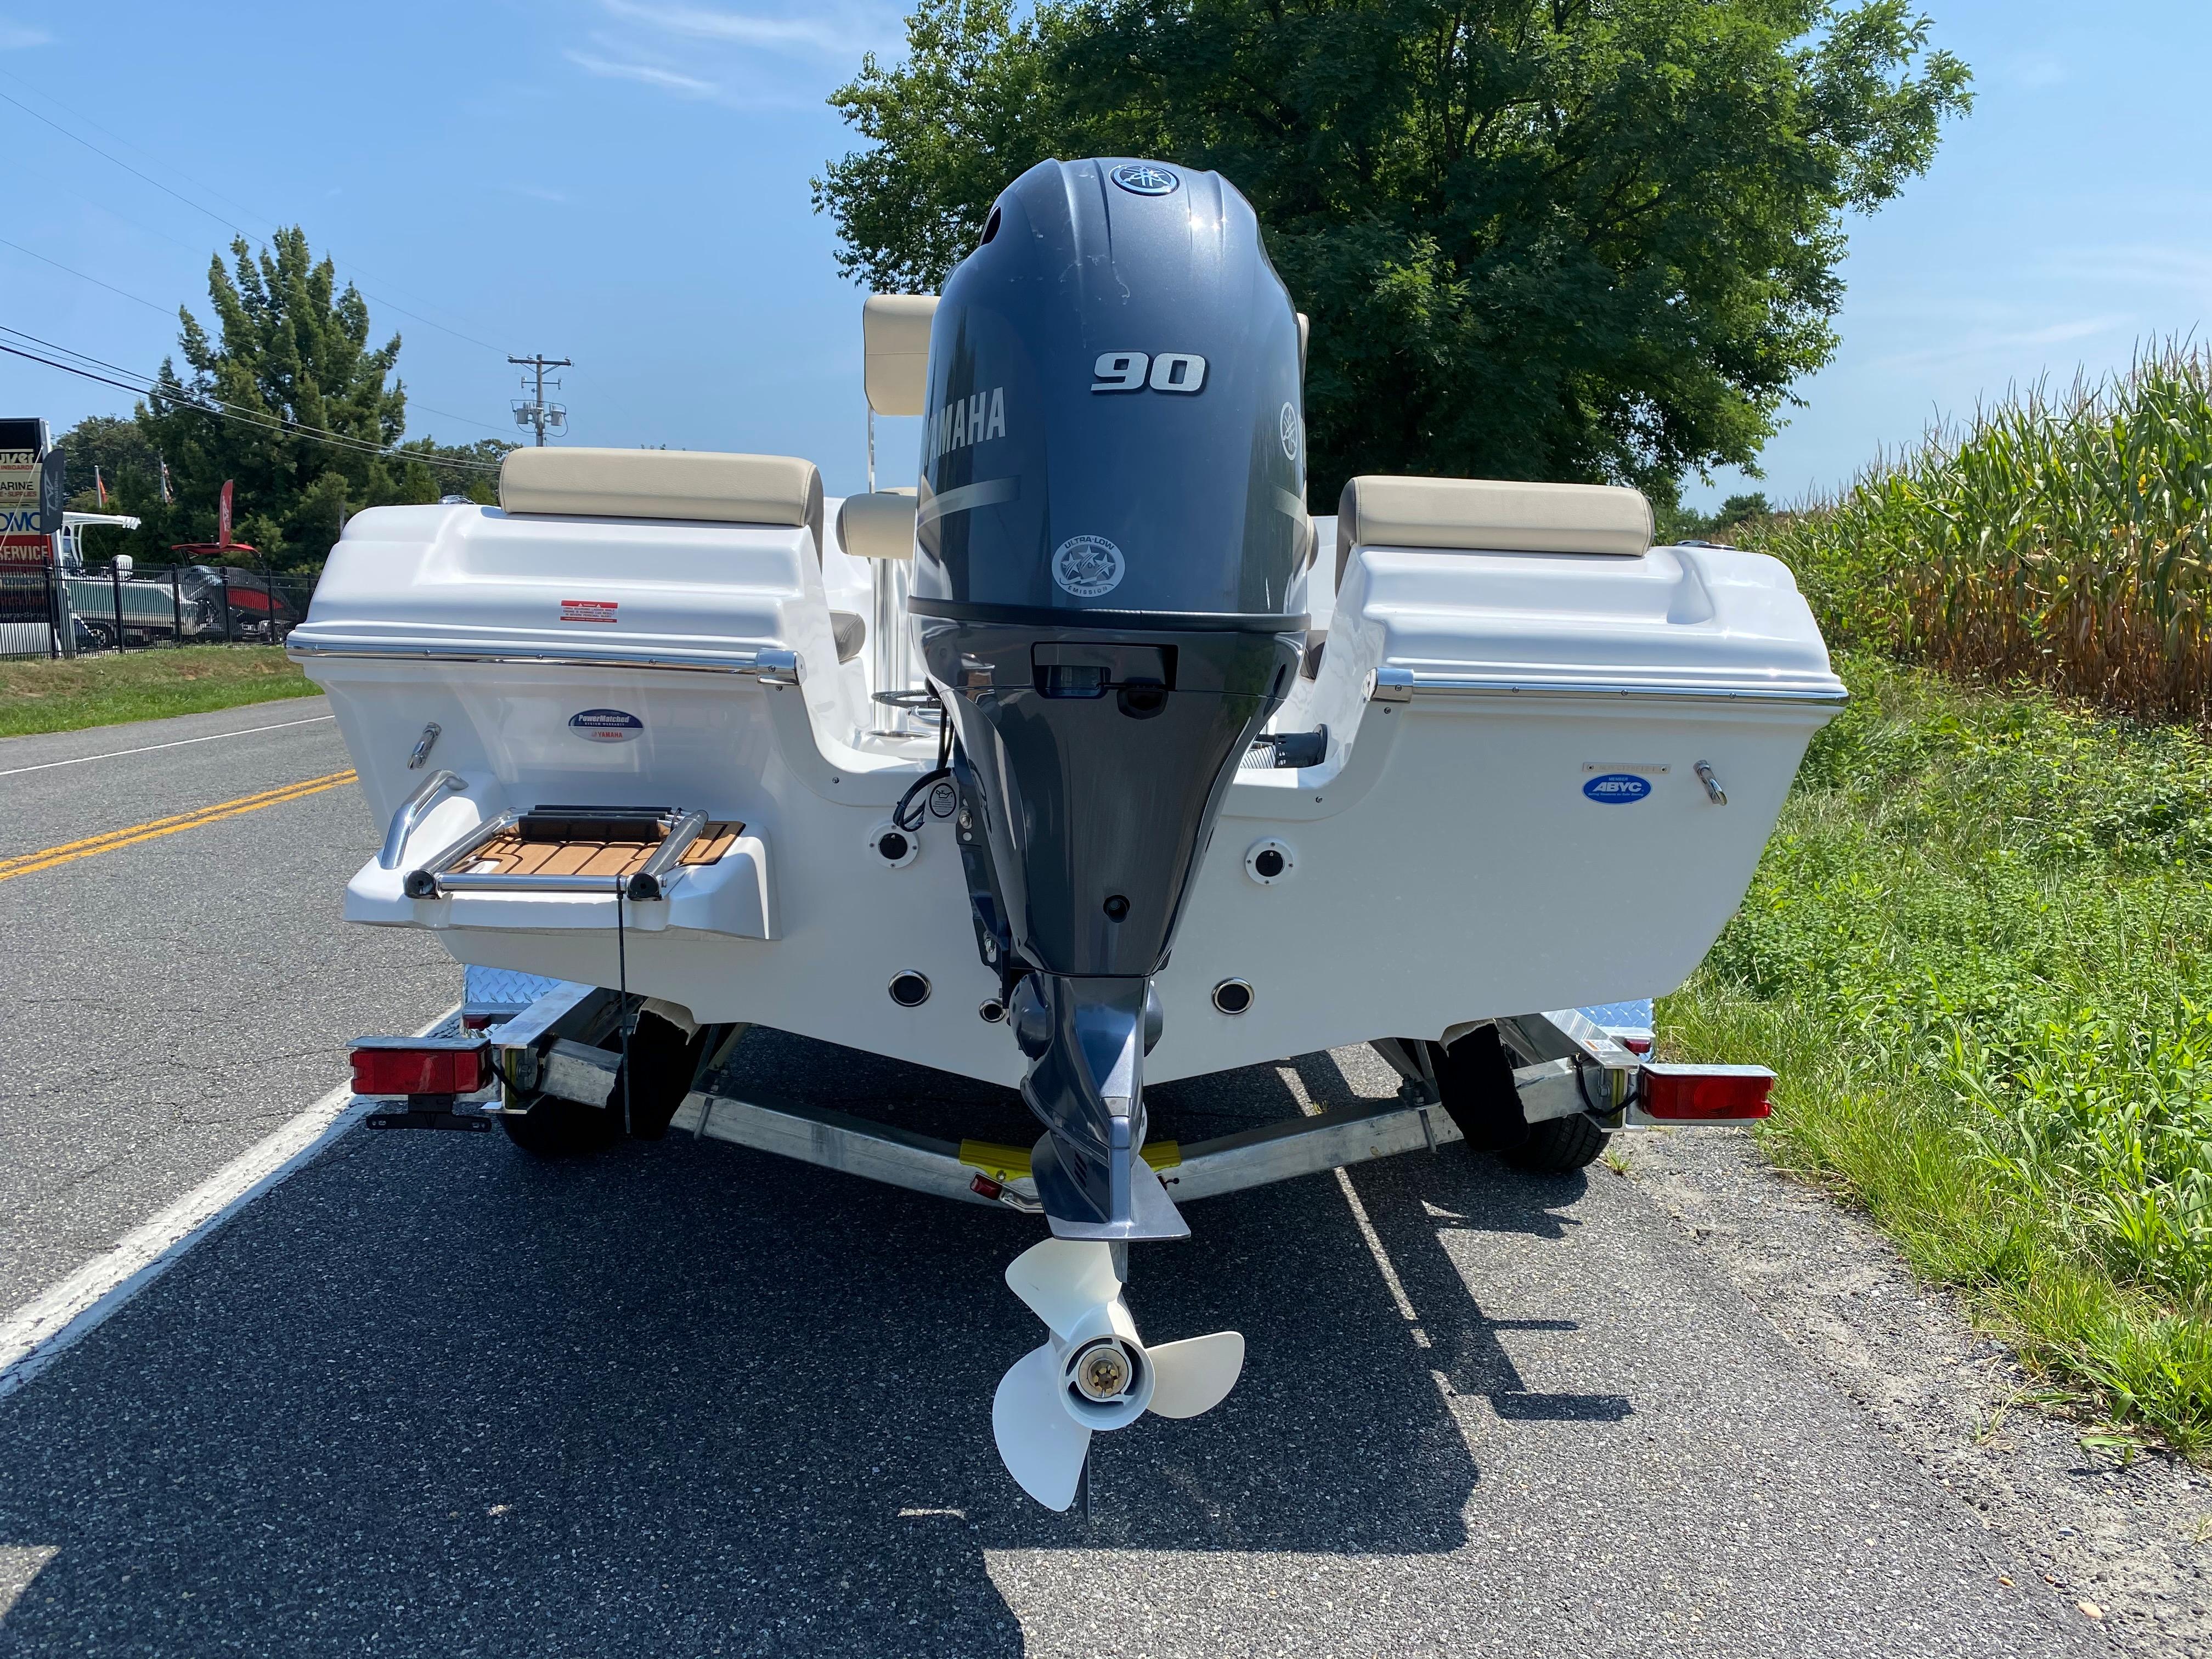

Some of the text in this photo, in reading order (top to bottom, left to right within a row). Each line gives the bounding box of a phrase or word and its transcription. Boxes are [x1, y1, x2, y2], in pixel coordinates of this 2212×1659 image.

[1091, 352, 1205, 391] 90
[1068, 585, 1107, 595] EMISSION
[579, 715, 629, 723] PowerMatched
[1592, 782, 1642, 792] ABYC
